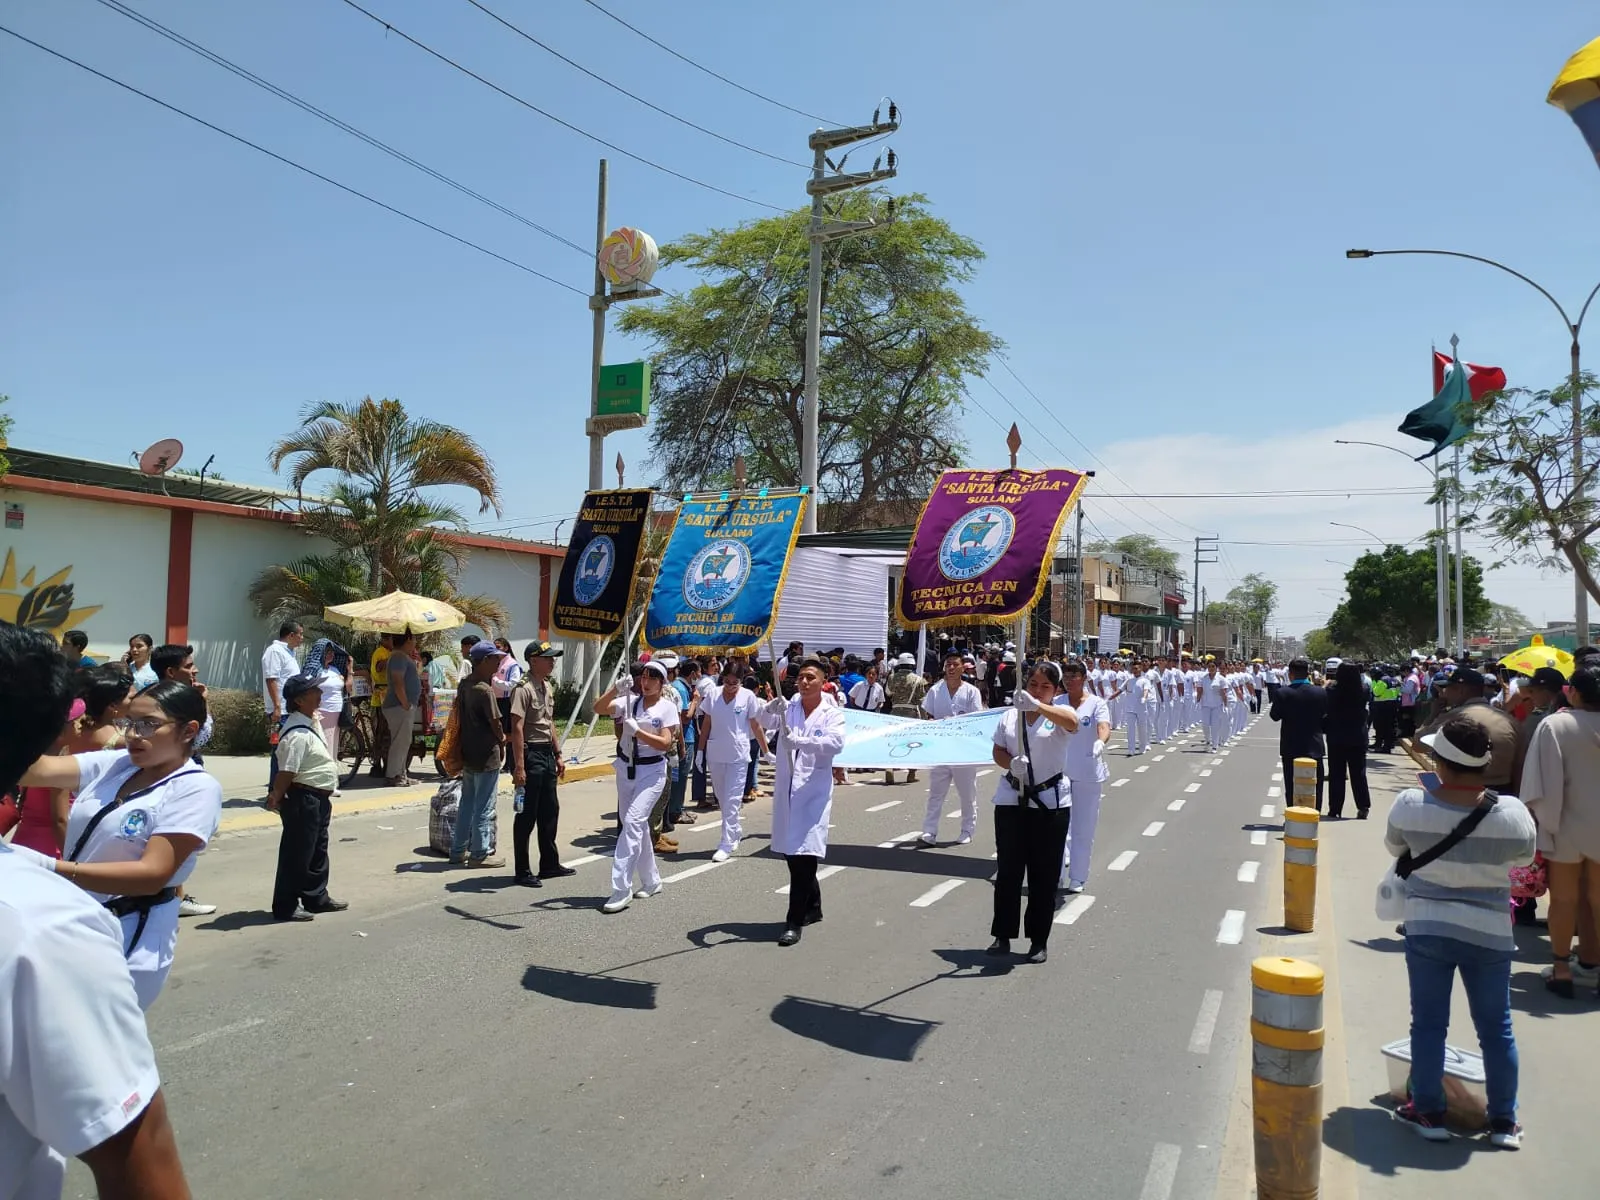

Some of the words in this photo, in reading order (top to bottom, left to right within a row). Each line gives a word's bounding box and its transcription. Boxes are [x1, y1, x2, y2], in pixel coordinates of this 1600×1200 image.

[966, 495, 1022, 504] SULLANA
[592, 524, 620, 534] SULLANA
[704, 528, 753, 538] SULLANA
[911, 583, 985, 601] TECNICA
[990, 580, 1018, 592] EN
[914, 593, 1006, 613] FARMACIA
[556, 605, 620, 622] NFERMERIA
[676, 612, 720, 624] TECNICA
[721, 611, 736, 622] EN
[559, 616, 601, 630] TECNICA
[650, 624, 715, 639] LABORATORIO
[717, 624, 763, 638] CLINICO
